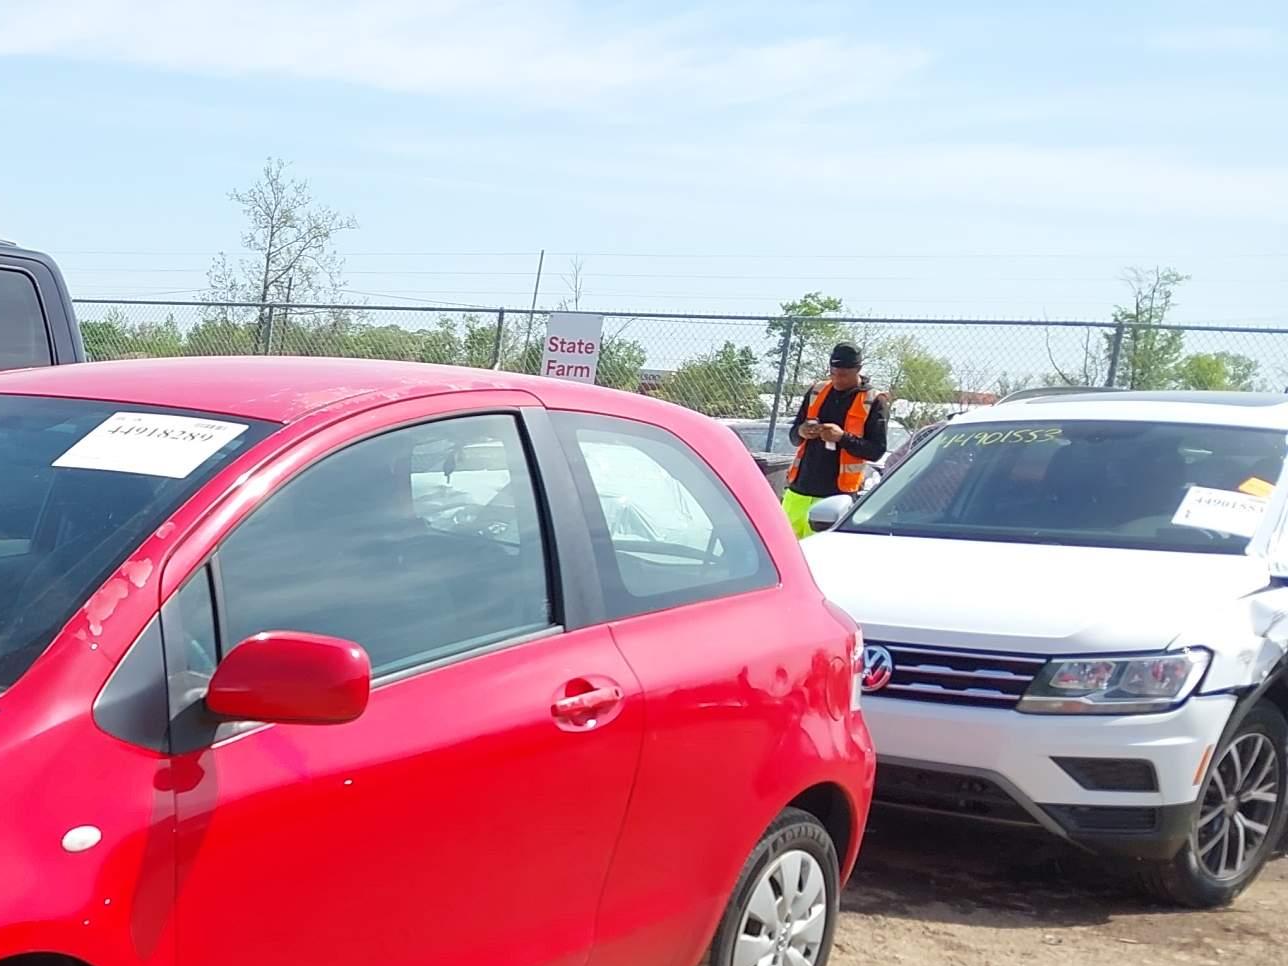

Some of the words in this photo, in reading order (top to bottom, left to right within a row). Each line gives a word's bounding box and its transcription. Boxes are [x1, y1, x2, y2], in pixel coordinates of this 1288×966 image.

[548, 336, 595, 354] State
[546, 360, 590, 378] Farm
[108, 425, 215, 442] 44918289
